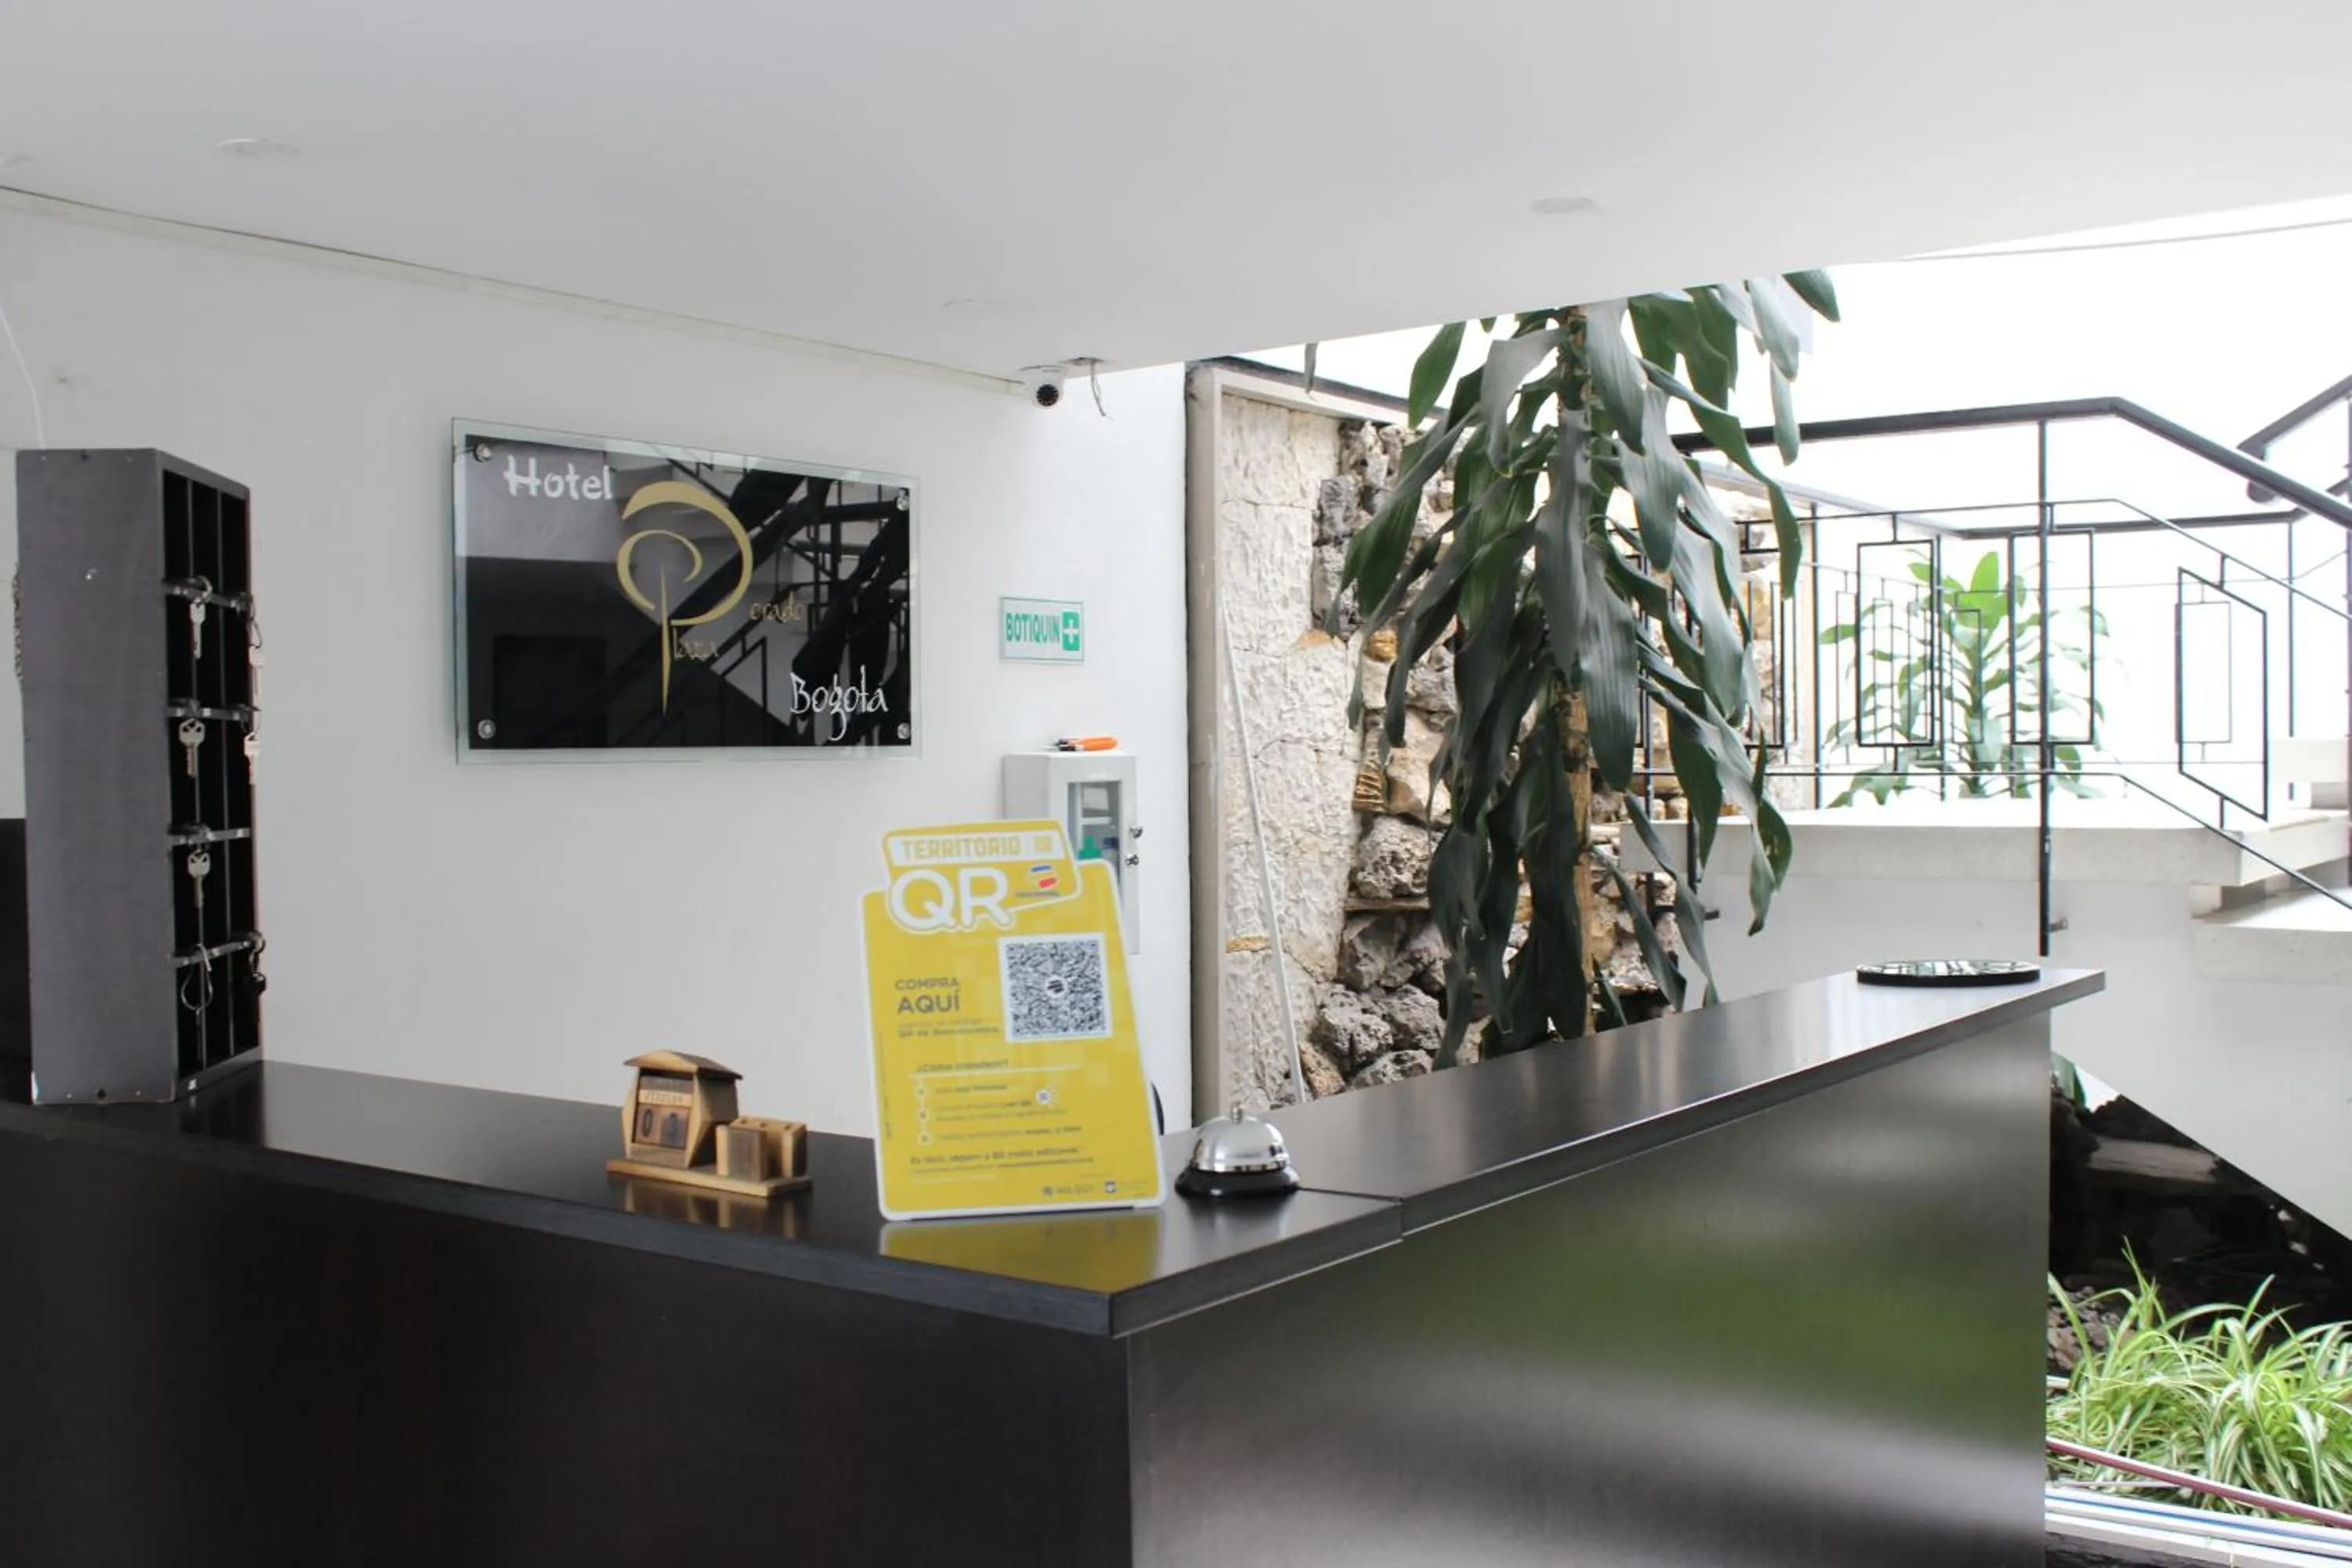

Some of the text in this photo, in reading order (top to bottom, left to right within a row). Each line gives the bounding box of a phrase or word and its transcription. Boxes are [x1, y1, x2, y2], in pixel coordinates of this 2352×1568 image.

[503, 454, 613, 500] Hotel
[1005, 612, 1061, 644] BOTIQUIN
[789, 665, 888, 741] Bogota
[901, 835, 1021, 859] TERRITORIO
[890, 866, 1012, 930] QR
[894, 977, 960, 991] COMPRA
[896, 988, 960, 1014] AQUÍ
